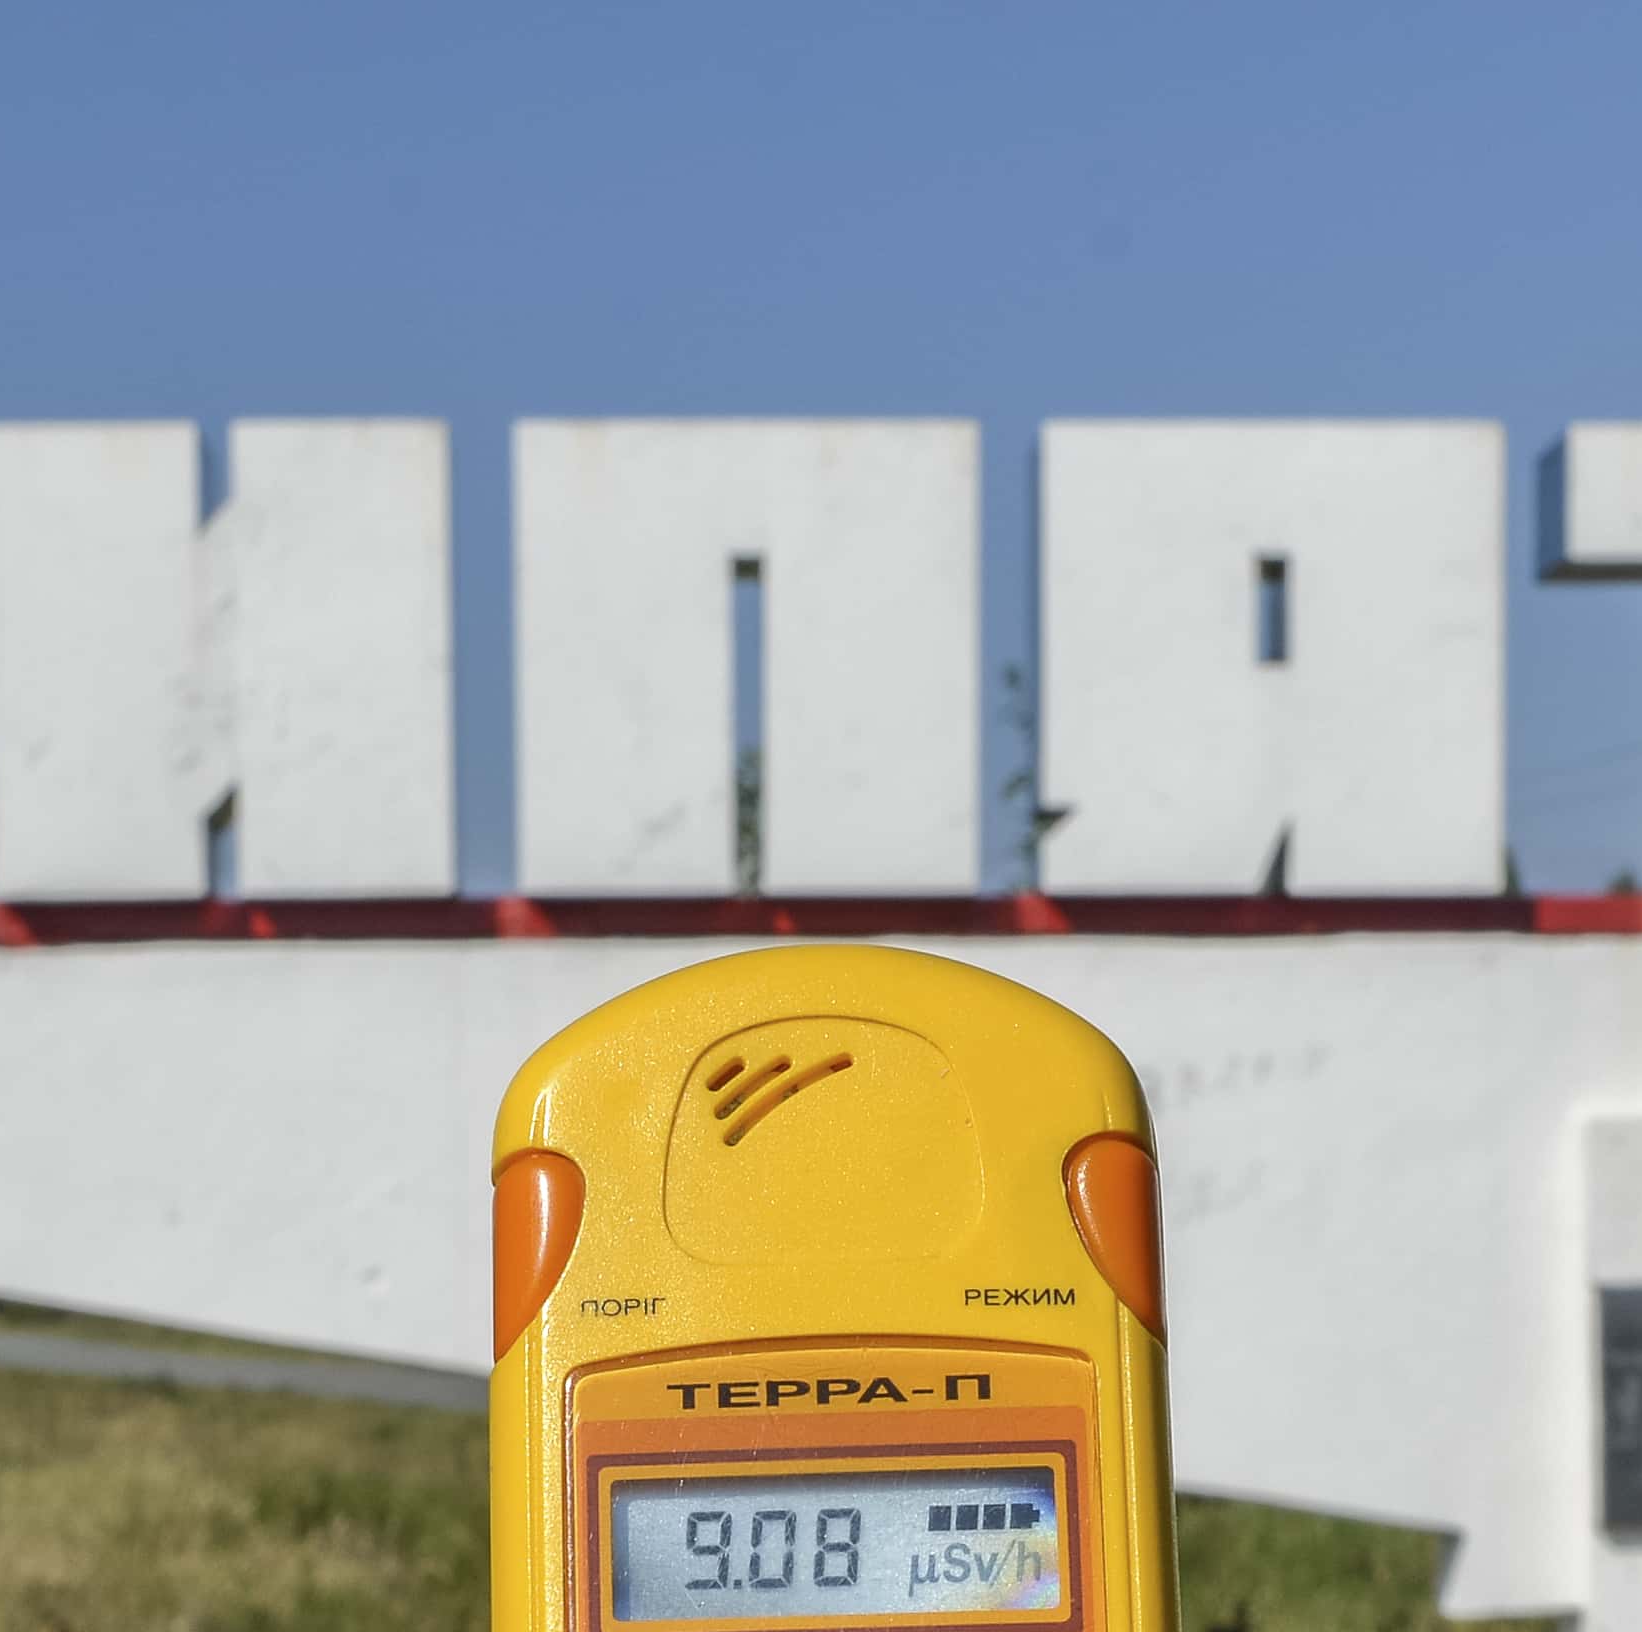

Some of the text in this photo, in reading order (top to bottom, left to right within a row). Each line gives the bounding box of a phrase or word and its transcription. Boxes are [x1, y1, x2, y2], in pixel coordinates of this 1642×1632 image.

[581, 1297, 666, 1317] ПОРІГ
[963, 1287, 1076, 1307] РЕЖИМ
[667, 1374, 991, 1410] ТЕРРА-П
[685, 1507, 862, 1590] 9.08
